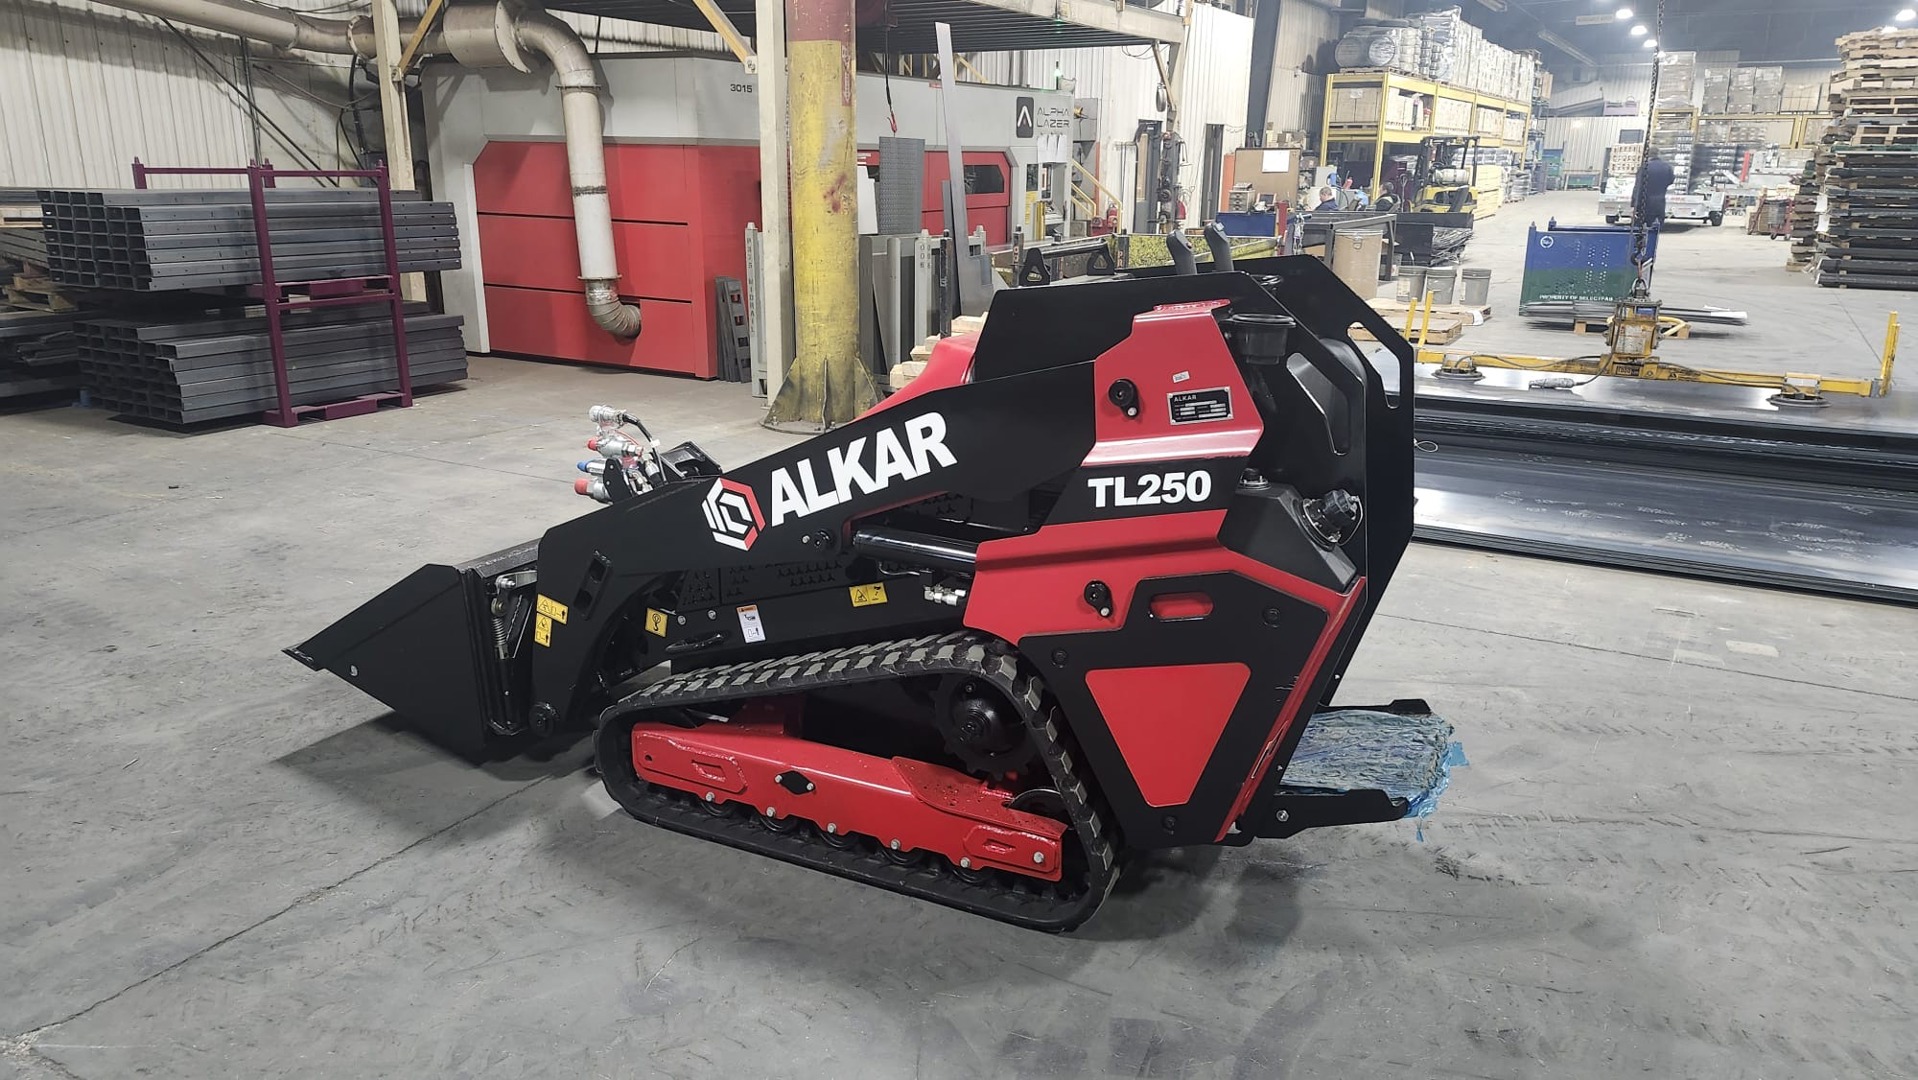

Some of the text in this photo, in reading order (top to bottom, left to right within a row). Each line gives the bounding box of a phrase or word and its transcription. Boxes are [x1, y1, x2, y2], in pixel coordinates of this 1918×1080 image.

[730, 83, 753, 93] 3015
[1037, 106, 1070, 117] ALPHA
[1037, 118, 1070, 128] LAZER
[1174, 394, 1197, 402] ALKAR
[771, 412, 958, 527] ALKAR
[1087, 470, 1212, 508] TL250
